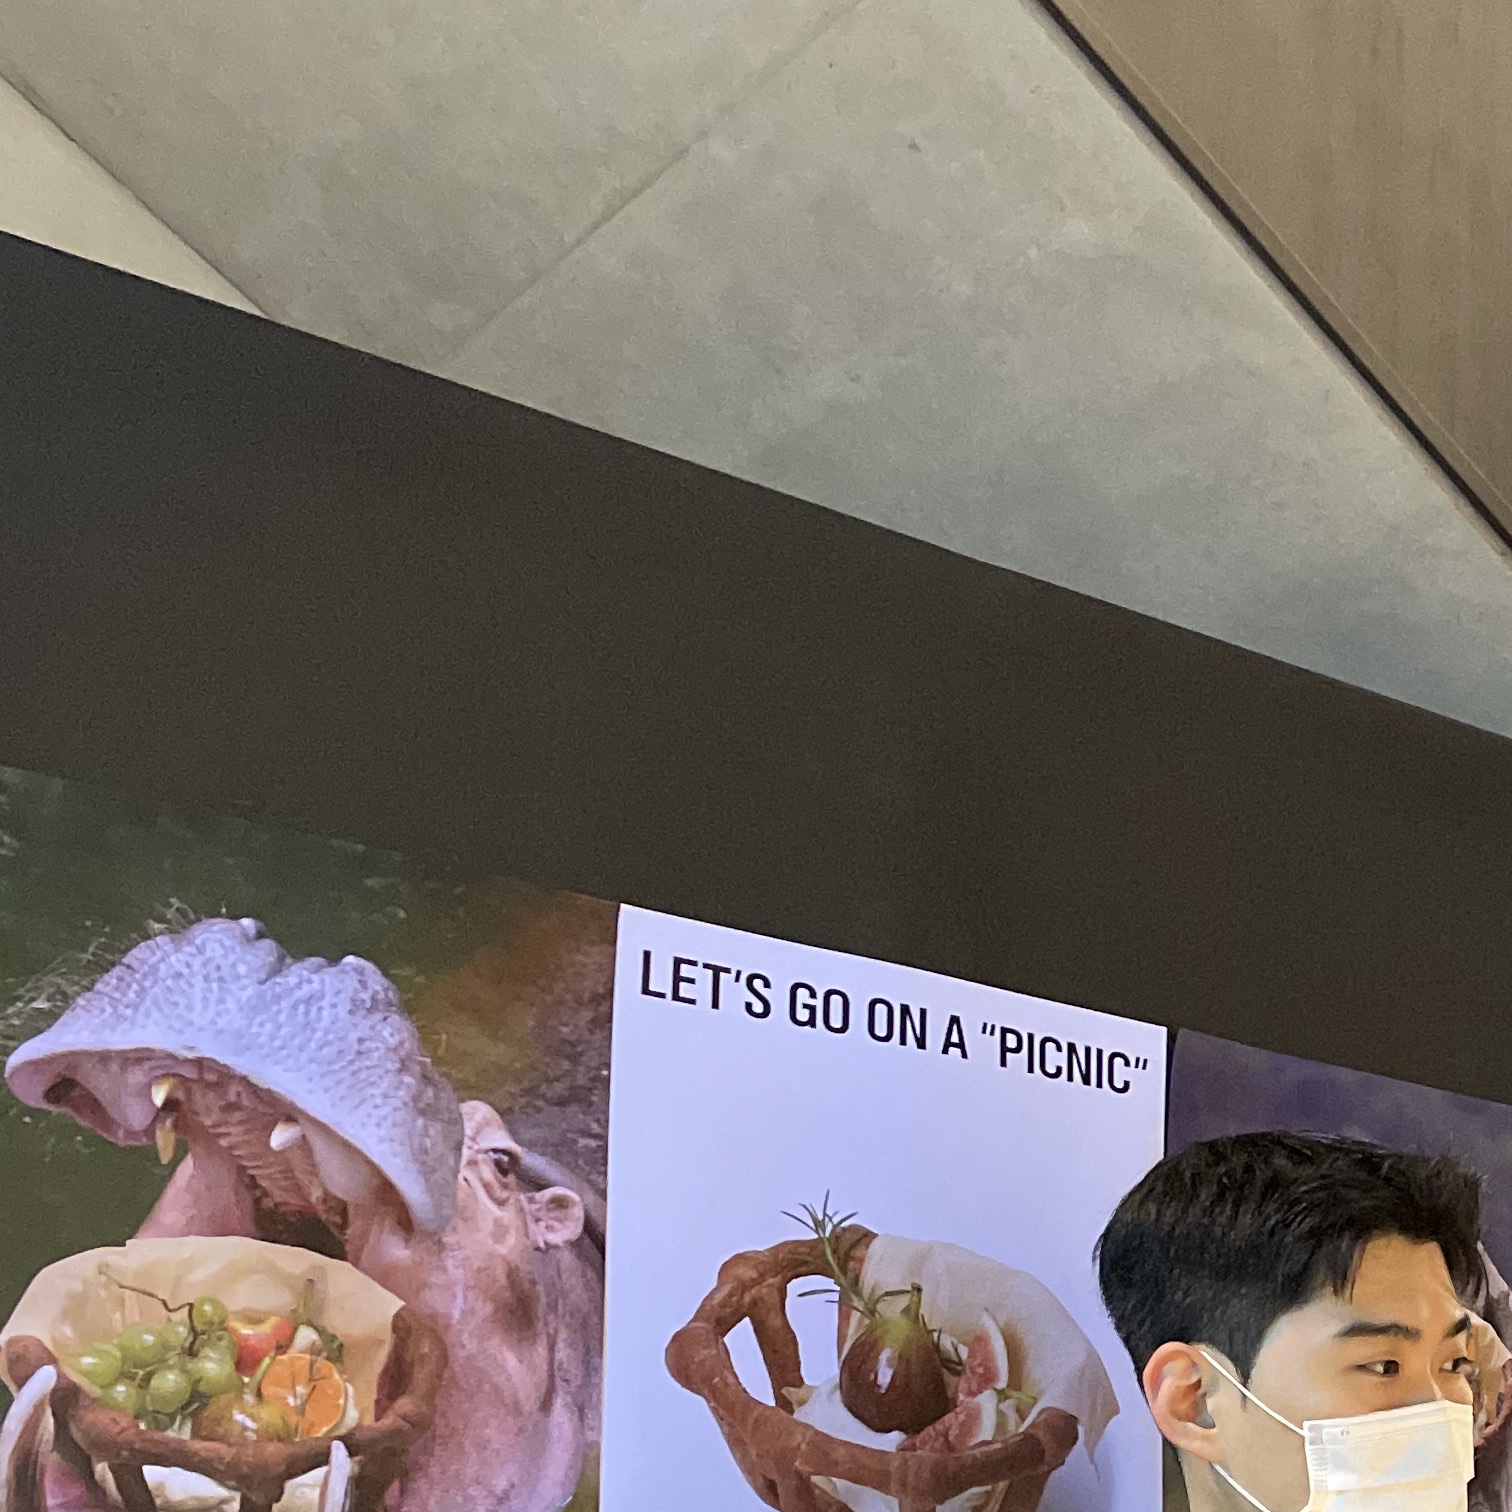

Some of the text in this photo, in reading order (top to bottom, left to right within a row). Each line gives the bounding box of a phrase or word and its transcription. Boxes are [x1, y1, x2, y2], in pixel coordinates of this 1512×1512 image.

[640, 949, 1148, 1094] LET'S GO ON A "PICNIC"
